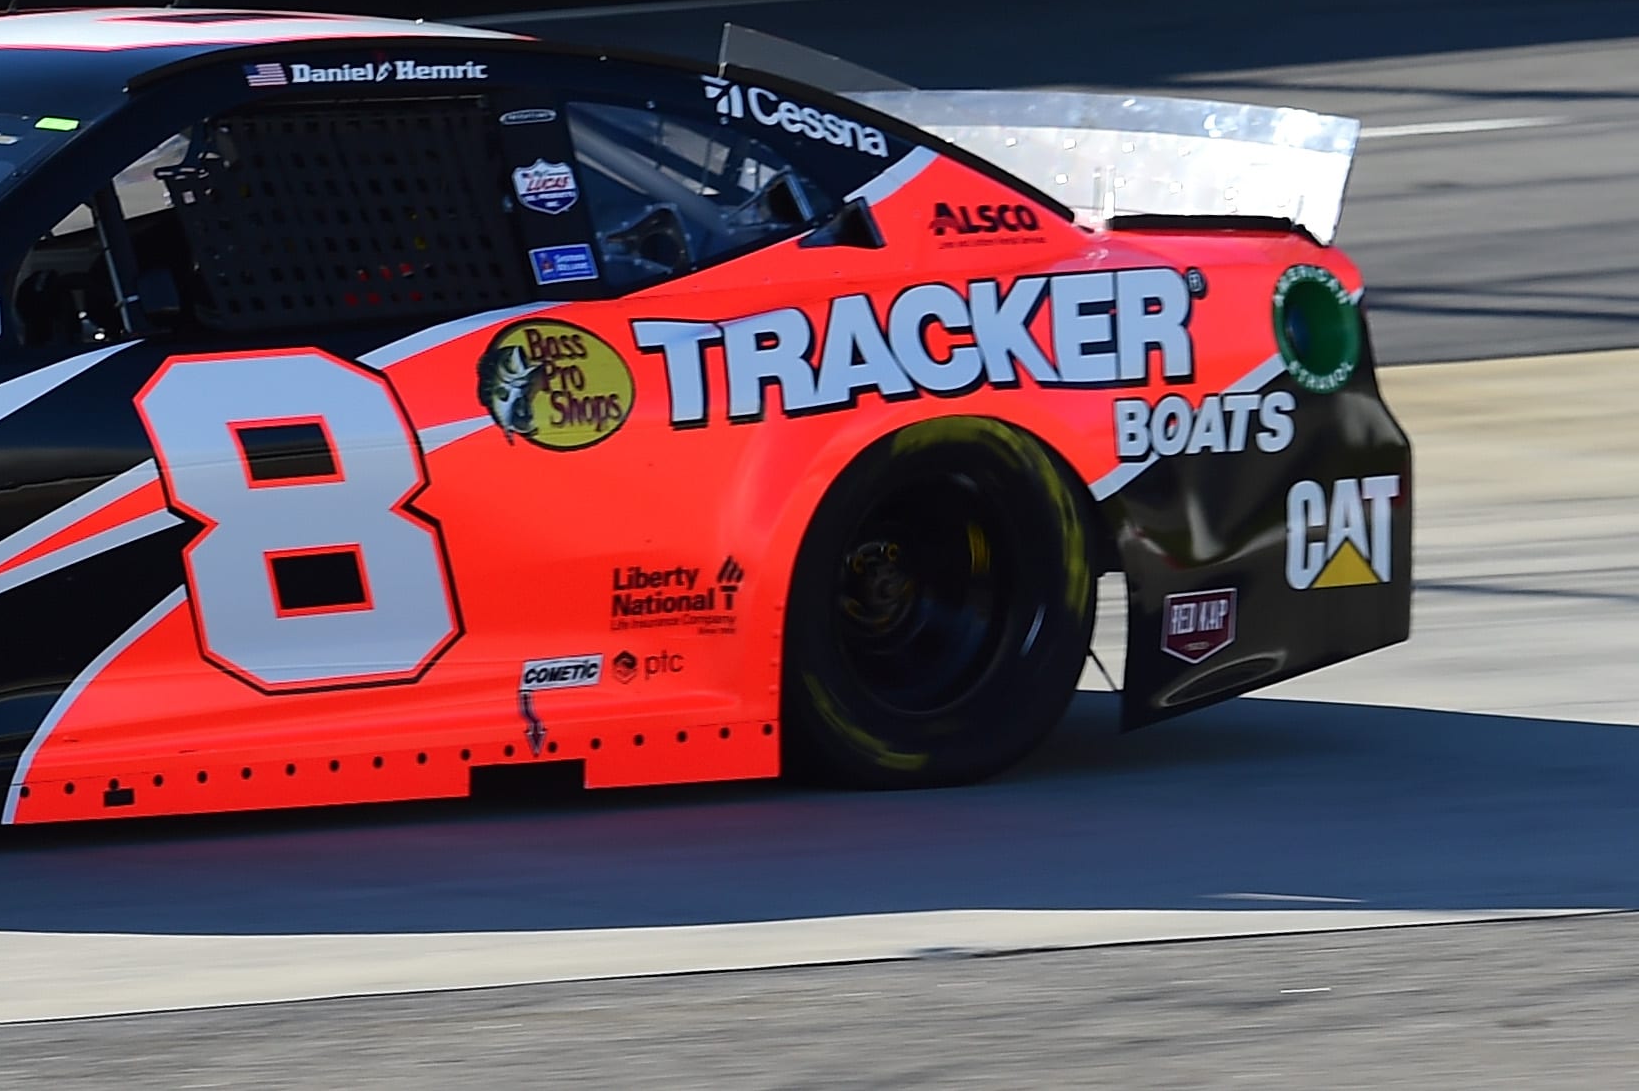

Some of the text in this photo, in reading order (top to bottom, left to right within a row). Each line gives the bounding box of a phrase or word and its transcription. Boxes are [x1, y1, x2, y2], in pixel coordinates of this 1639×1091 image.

[290, 60, 488, 83] Daniel Hemric
[748, 87, 888, 157] Cessna
[932, 202, 1040, 236] ALSCO
[524, 329, 587, 360] Bass
[631, 267, 1194, 429] TRACKER
[542, 360, 585, 391] Pro
[551, 391, 622, 432] Shops
[1114, 391, 1296, 461] BOATS
[133, 347, 465, 695] 8
[1286, 474, 1400, 590] CAT
[613, 567, 699, 590] Liberty
[612, 587, 715, 617] National
